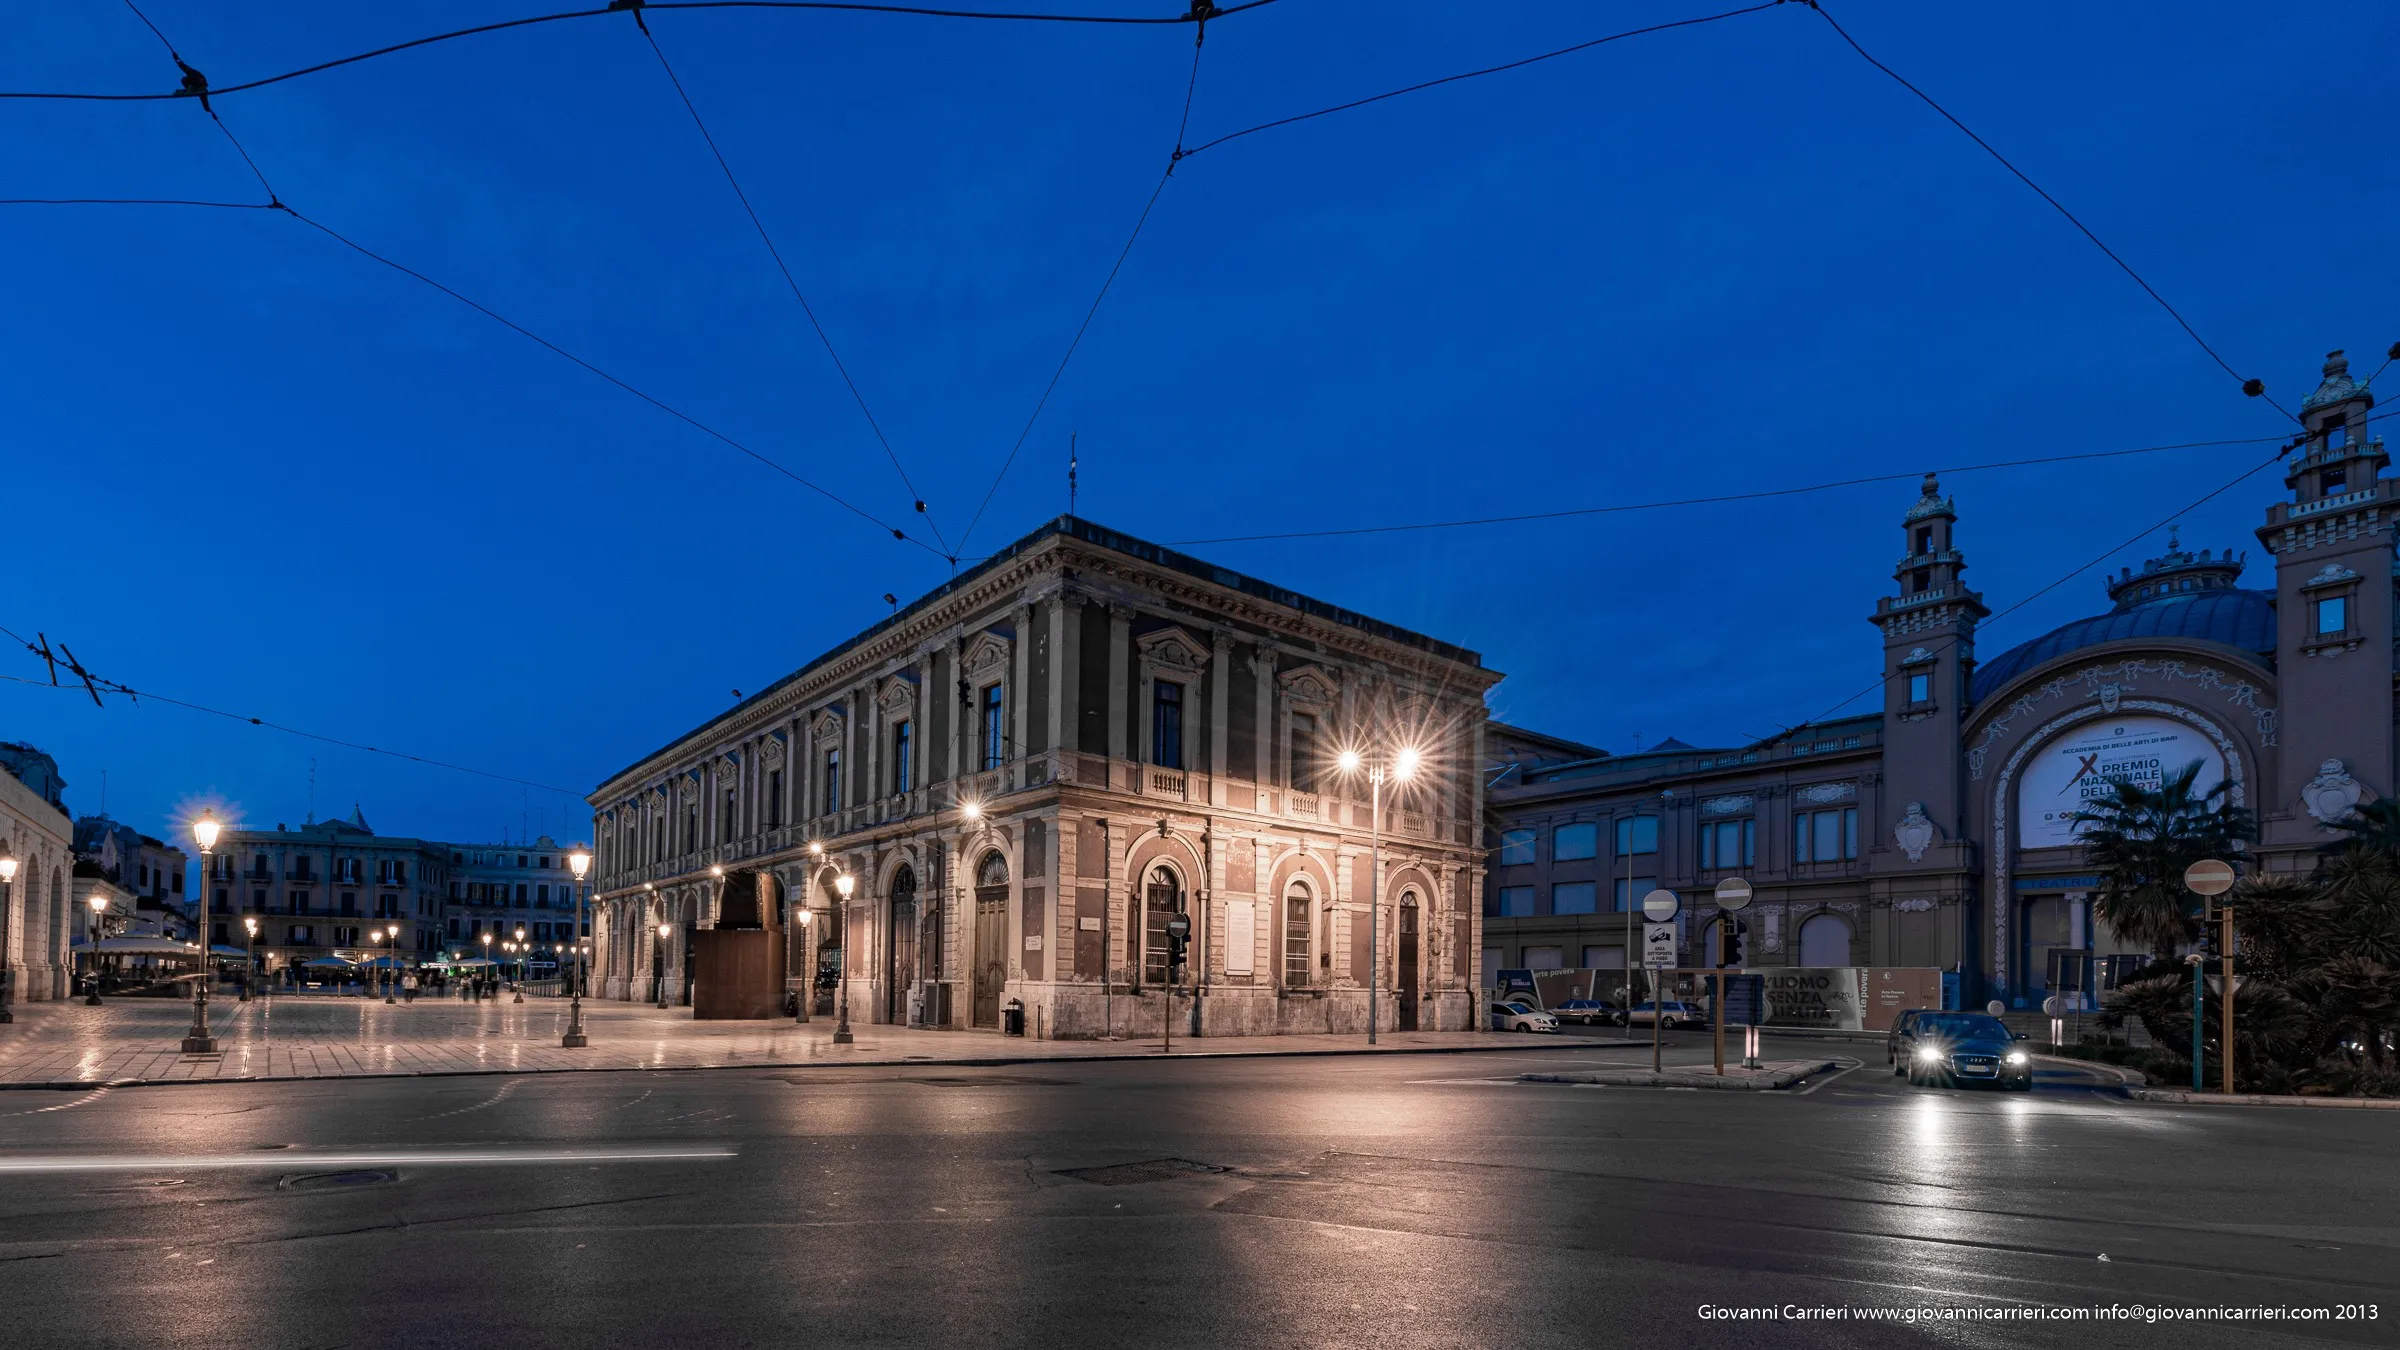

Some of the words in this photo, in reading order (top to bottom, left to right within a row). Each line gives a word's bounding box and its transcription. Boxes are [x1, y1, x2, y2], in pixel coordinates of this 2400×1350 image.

[2062, 745, 2102, 754] ACCADEMIA
[2111, 741, 2132, 749] BELLE
[2102, 758, 2160, 774] PREMIO
[2080, 769, 2160, 787] NAZIONALE
[1534, 970, 1549, 978] arte
[1550, 968, 1575, 978] povera
[1860, 968, 1869, 998] povera
[1767, 991, 1823, 1004] SENZA
